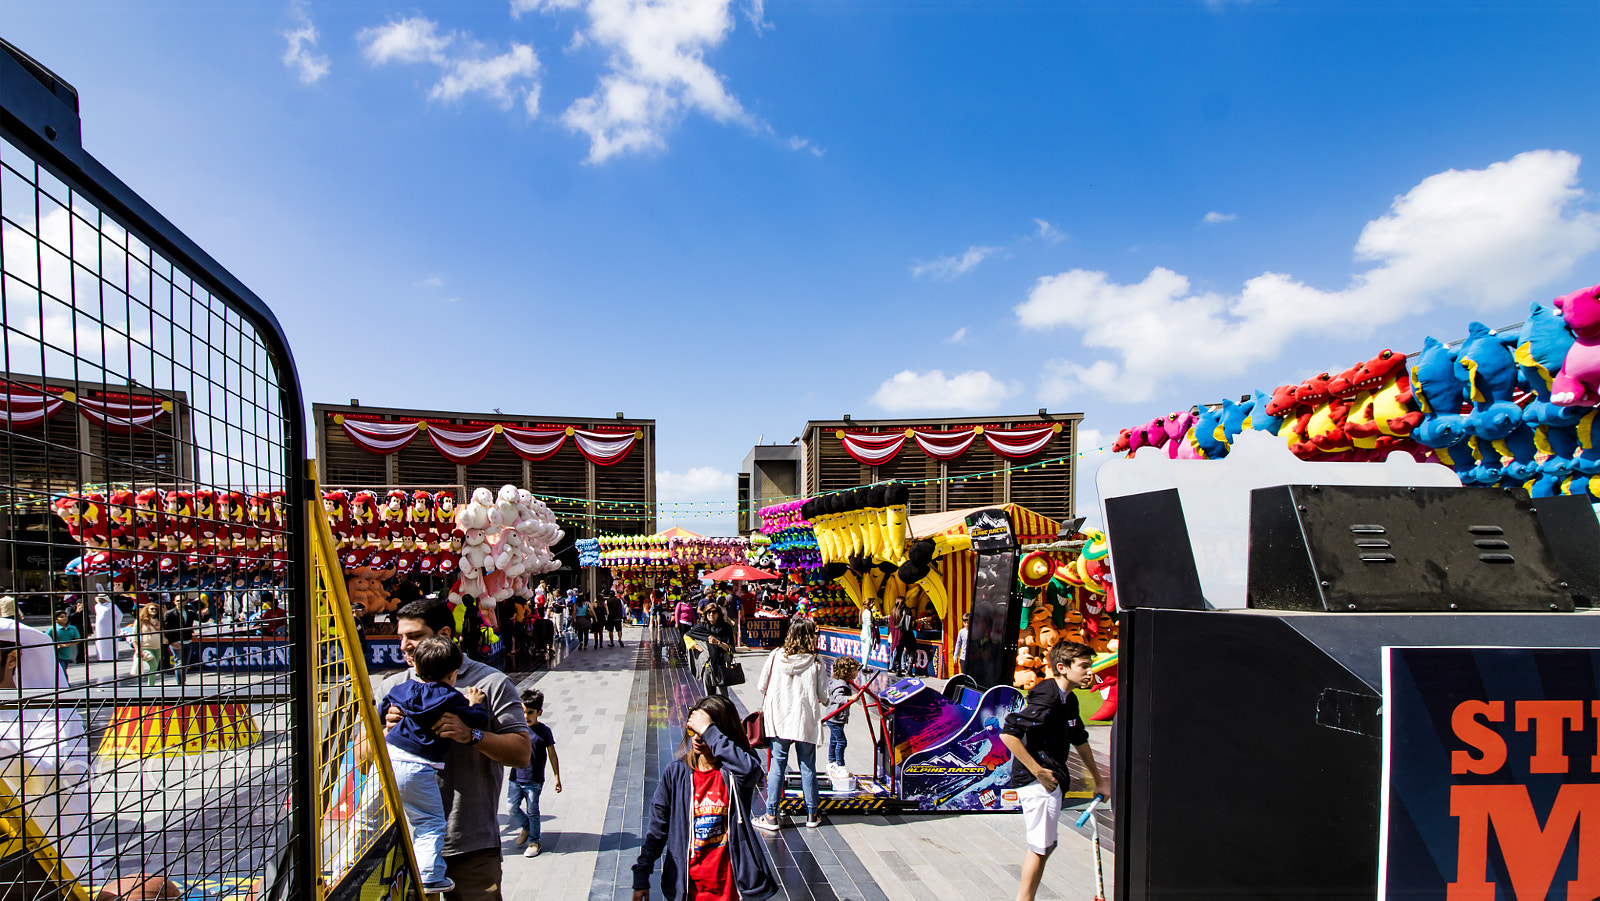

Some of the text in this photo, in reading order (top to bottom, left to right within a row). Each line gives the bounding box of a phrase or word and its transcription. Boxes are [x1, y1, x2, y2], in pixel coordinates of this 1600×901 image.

[747, 620, 780, 630] ONE IN
[747, 630, 780, 639] TO WIN
[1451, 700, 1600, 775] ST
